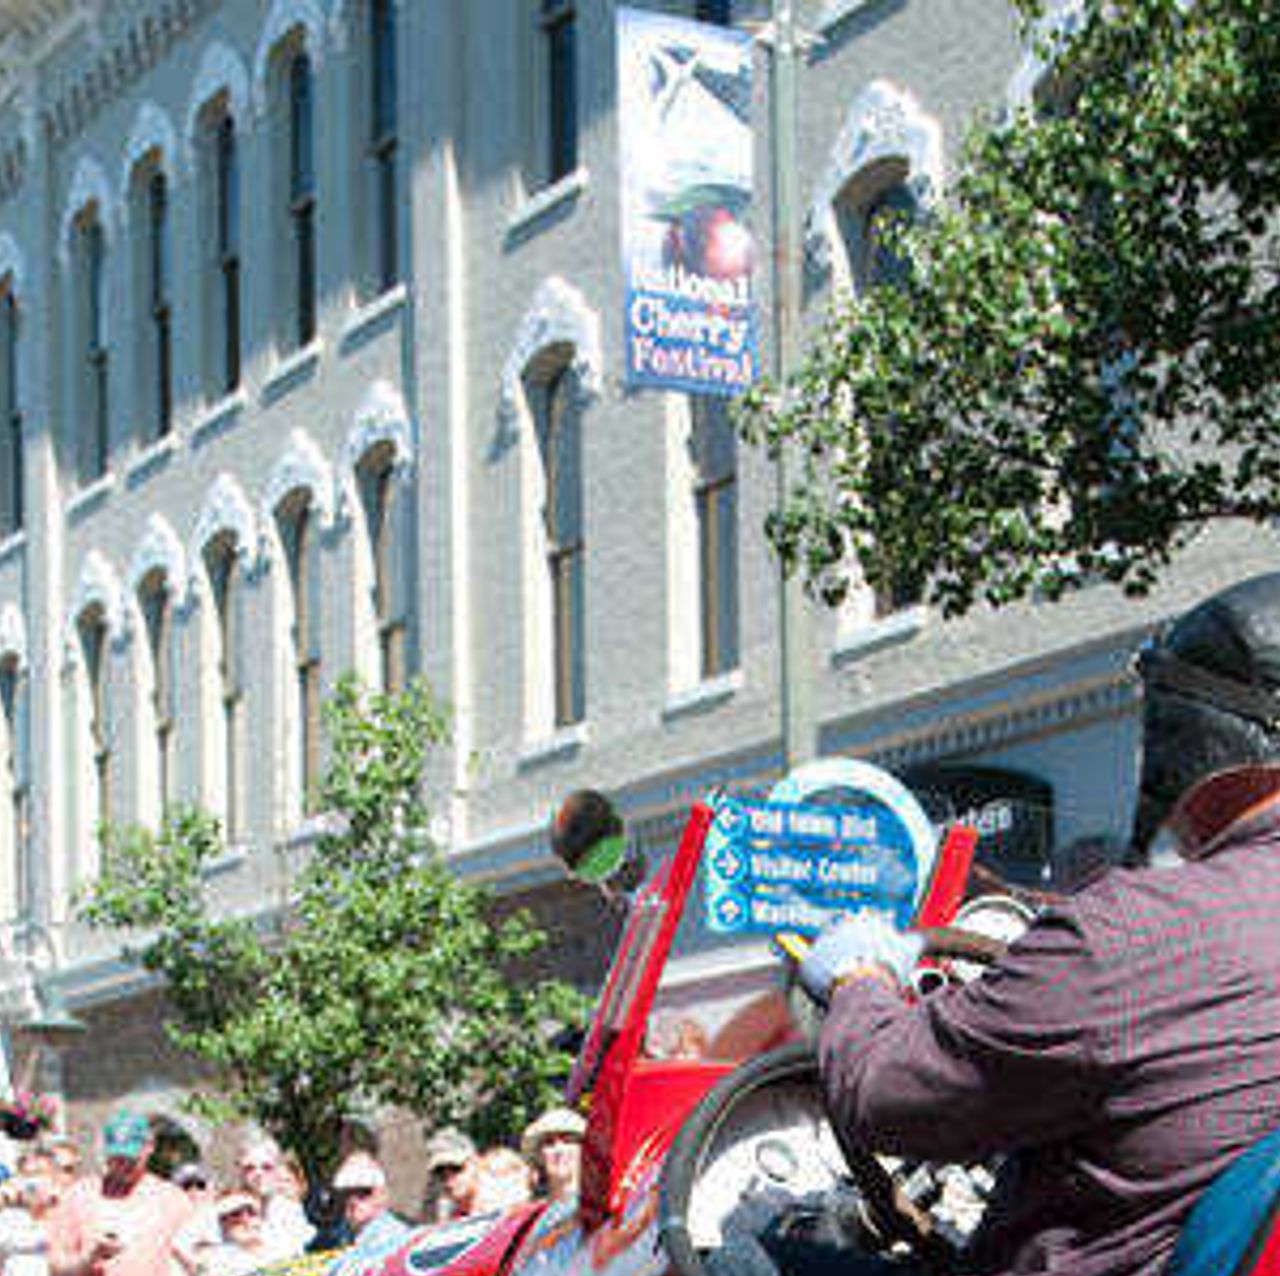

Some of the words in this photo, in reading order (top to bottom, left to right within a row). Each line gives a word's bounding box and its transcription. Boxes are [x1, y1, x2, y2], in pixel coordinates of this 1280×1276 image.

[631, 256, 749, 306] National
[631, 296, 749, 354] Cherry
[632, 337, 751, 385] Festival
[750, 853, 812, 882] Visitor
[818, 857, 878, 886] Center
